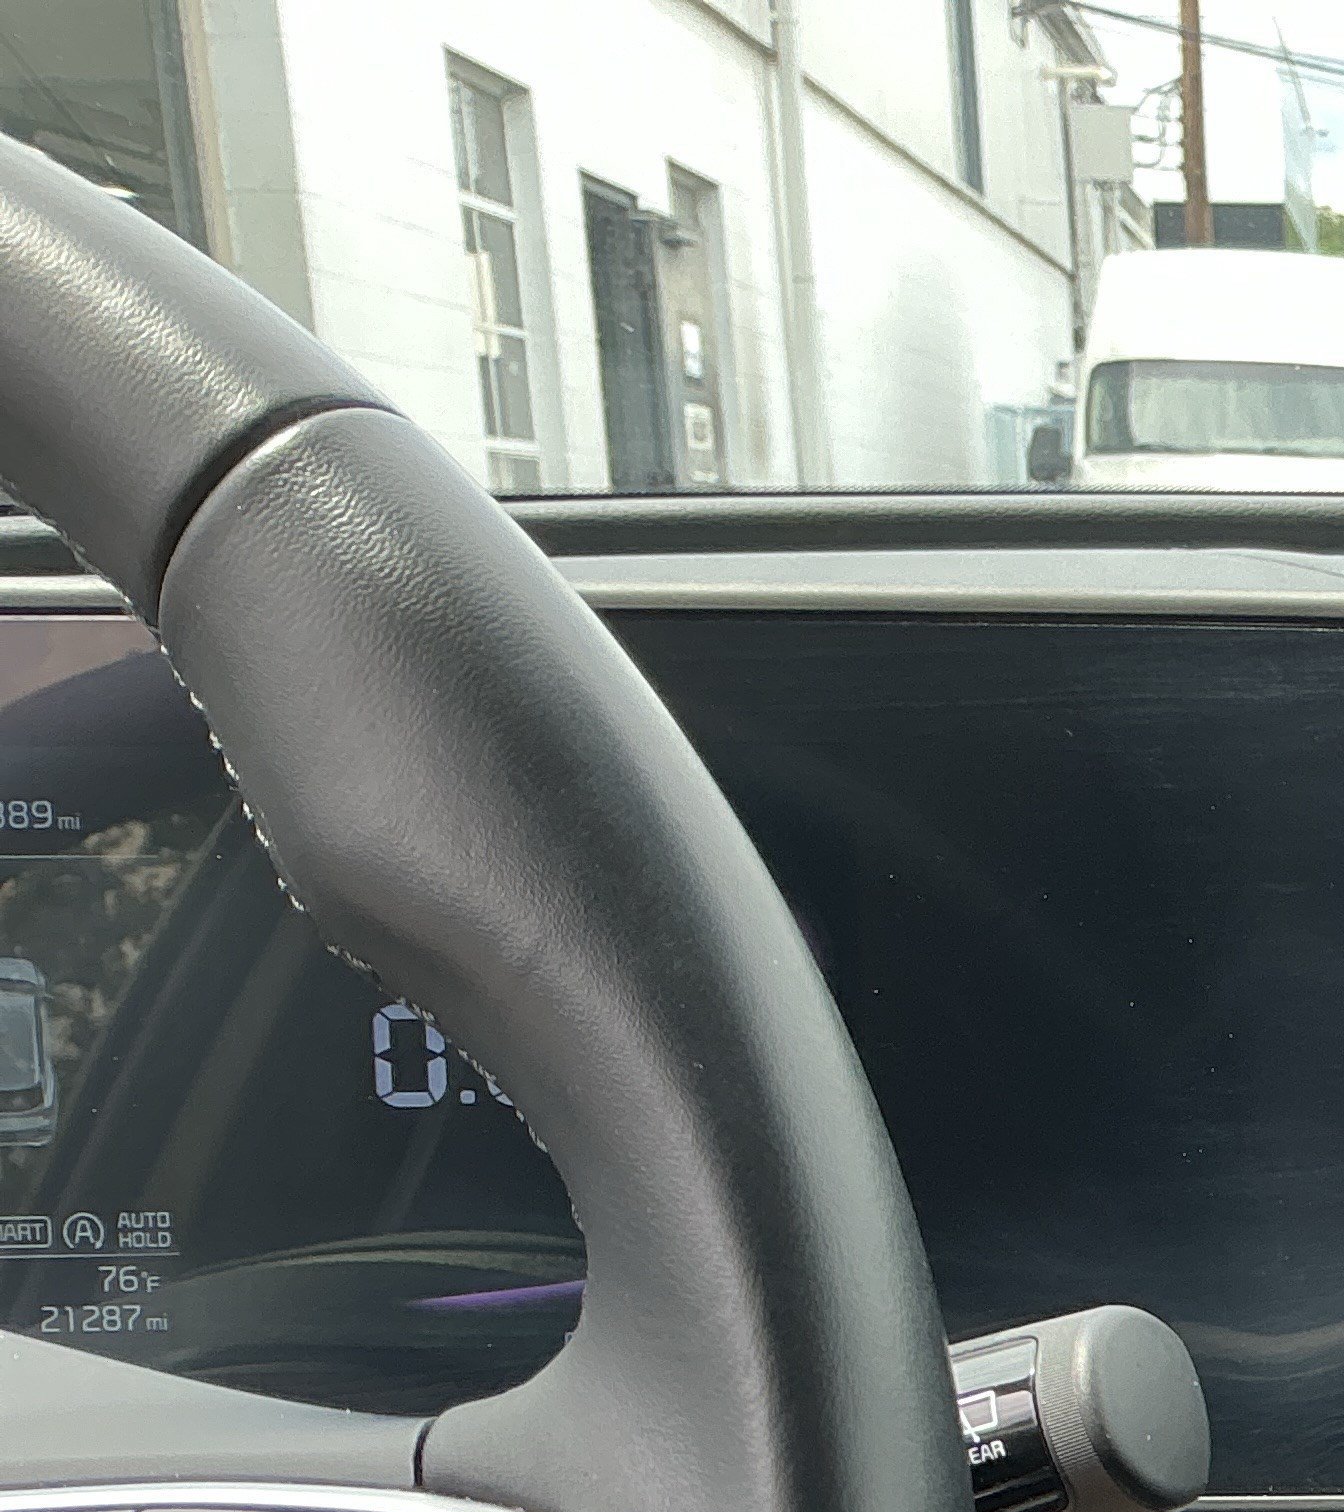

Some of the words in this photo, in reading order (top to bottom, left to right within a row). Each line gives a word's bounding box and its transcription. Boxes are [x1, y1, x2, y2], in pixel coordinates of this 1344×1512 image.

[0, 799, 54, 830] 89
[116, 1211, 171, 1229] AUTO
[0, 1222, 45, 1242] ART
[118, 1231, 172, 1248] HOLD
[39, 1305, 142, 1333] 21287
[145, 1312, 169, 1332] mi
[967, 1439, 1007, 1465] EAR
